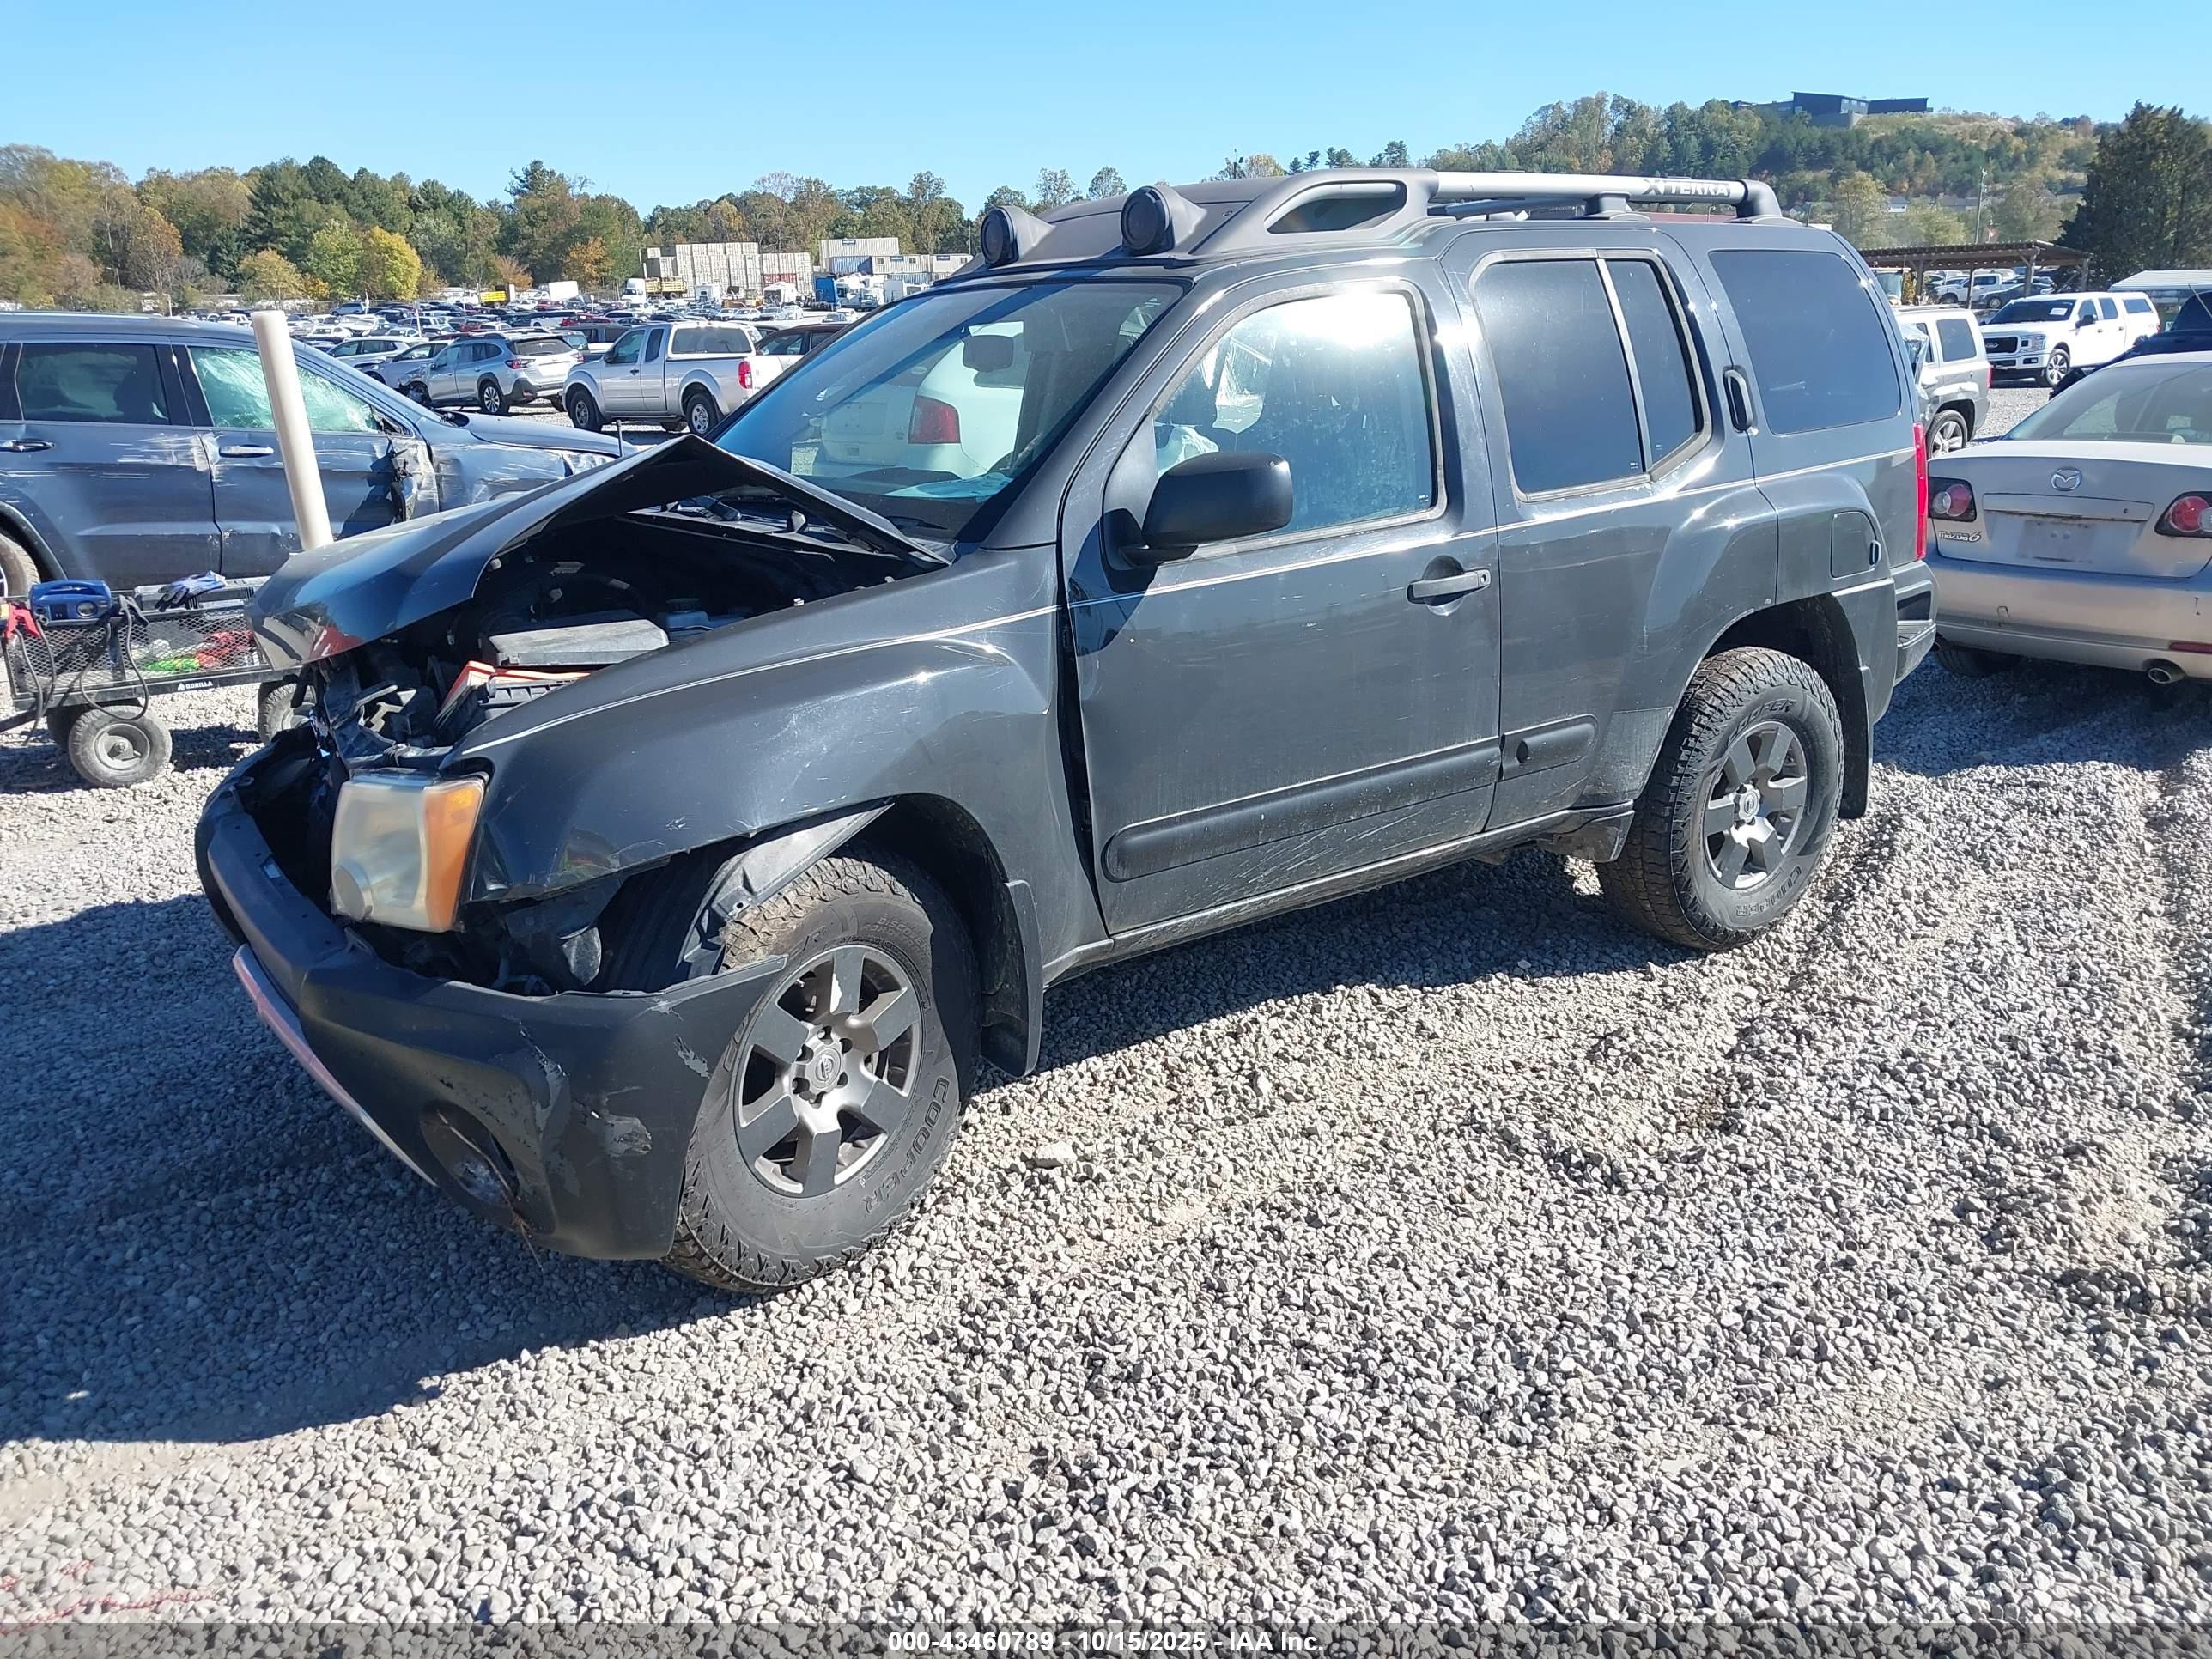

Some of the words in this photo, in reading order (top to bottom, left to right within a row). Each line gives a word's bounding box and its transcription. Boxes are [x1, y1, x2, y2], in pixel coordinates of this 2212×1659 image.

[1642, 179, 1731, 198] XTERRA
[185, 680, 213, 690] GORILLA
[1735, 865, 1802, 917] COOPER
[862, 1076, 951, 1215] COOPER
